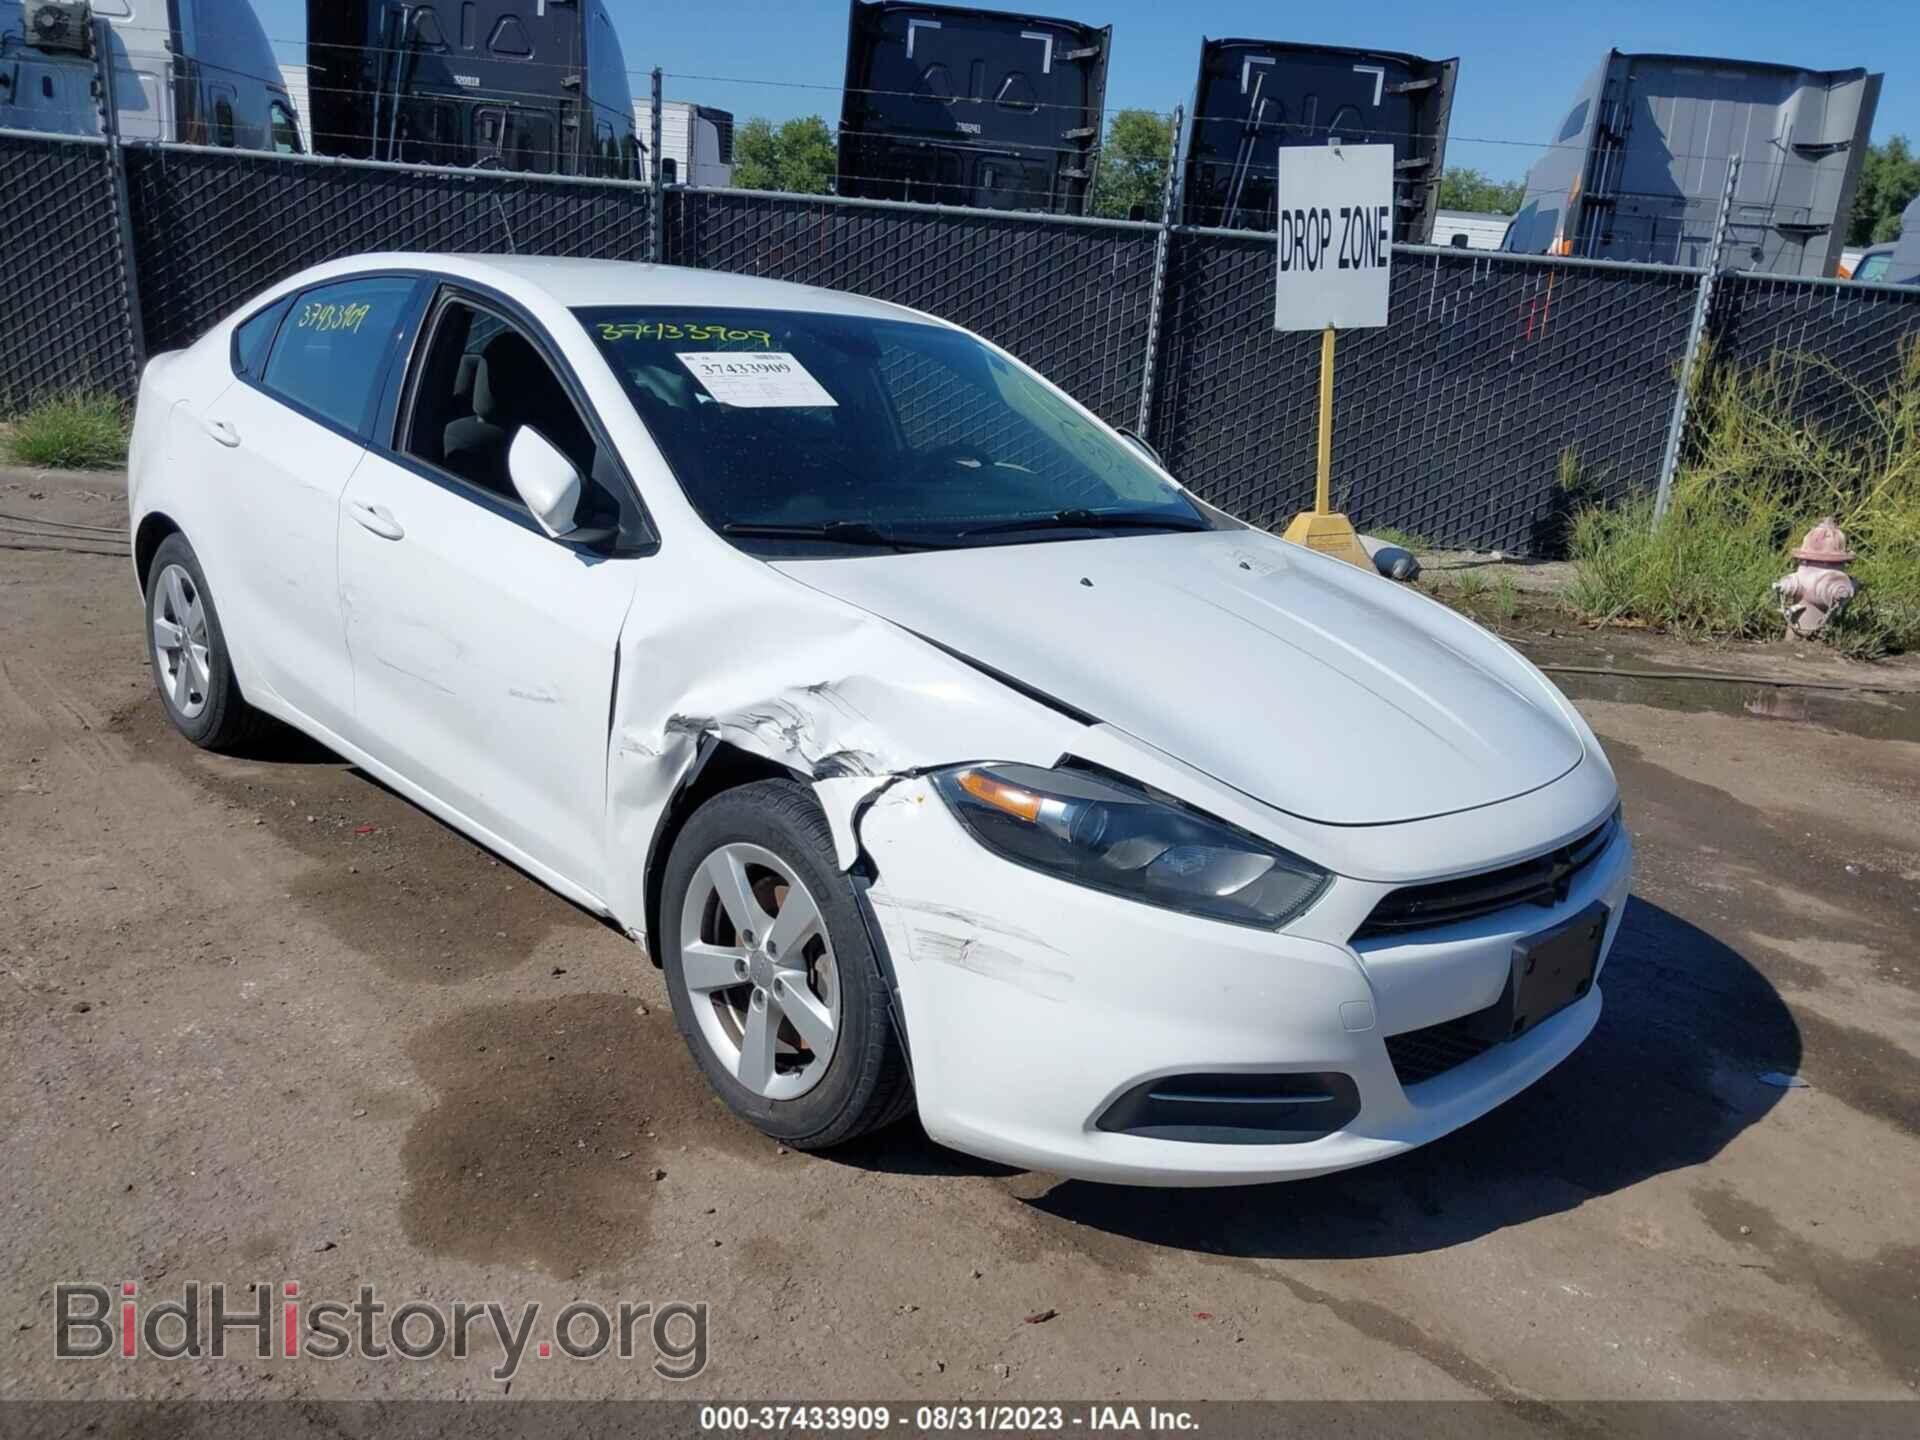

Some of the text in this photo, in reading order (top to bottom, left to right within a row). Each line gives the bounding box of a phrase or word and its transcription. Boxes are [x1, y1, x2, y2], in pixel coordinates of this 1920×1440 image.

[1281, 206, 1388, 272] DROP ZONE
[598, 323, 770, 347] 37433909
[700, 363, 791, 375] 37433909
